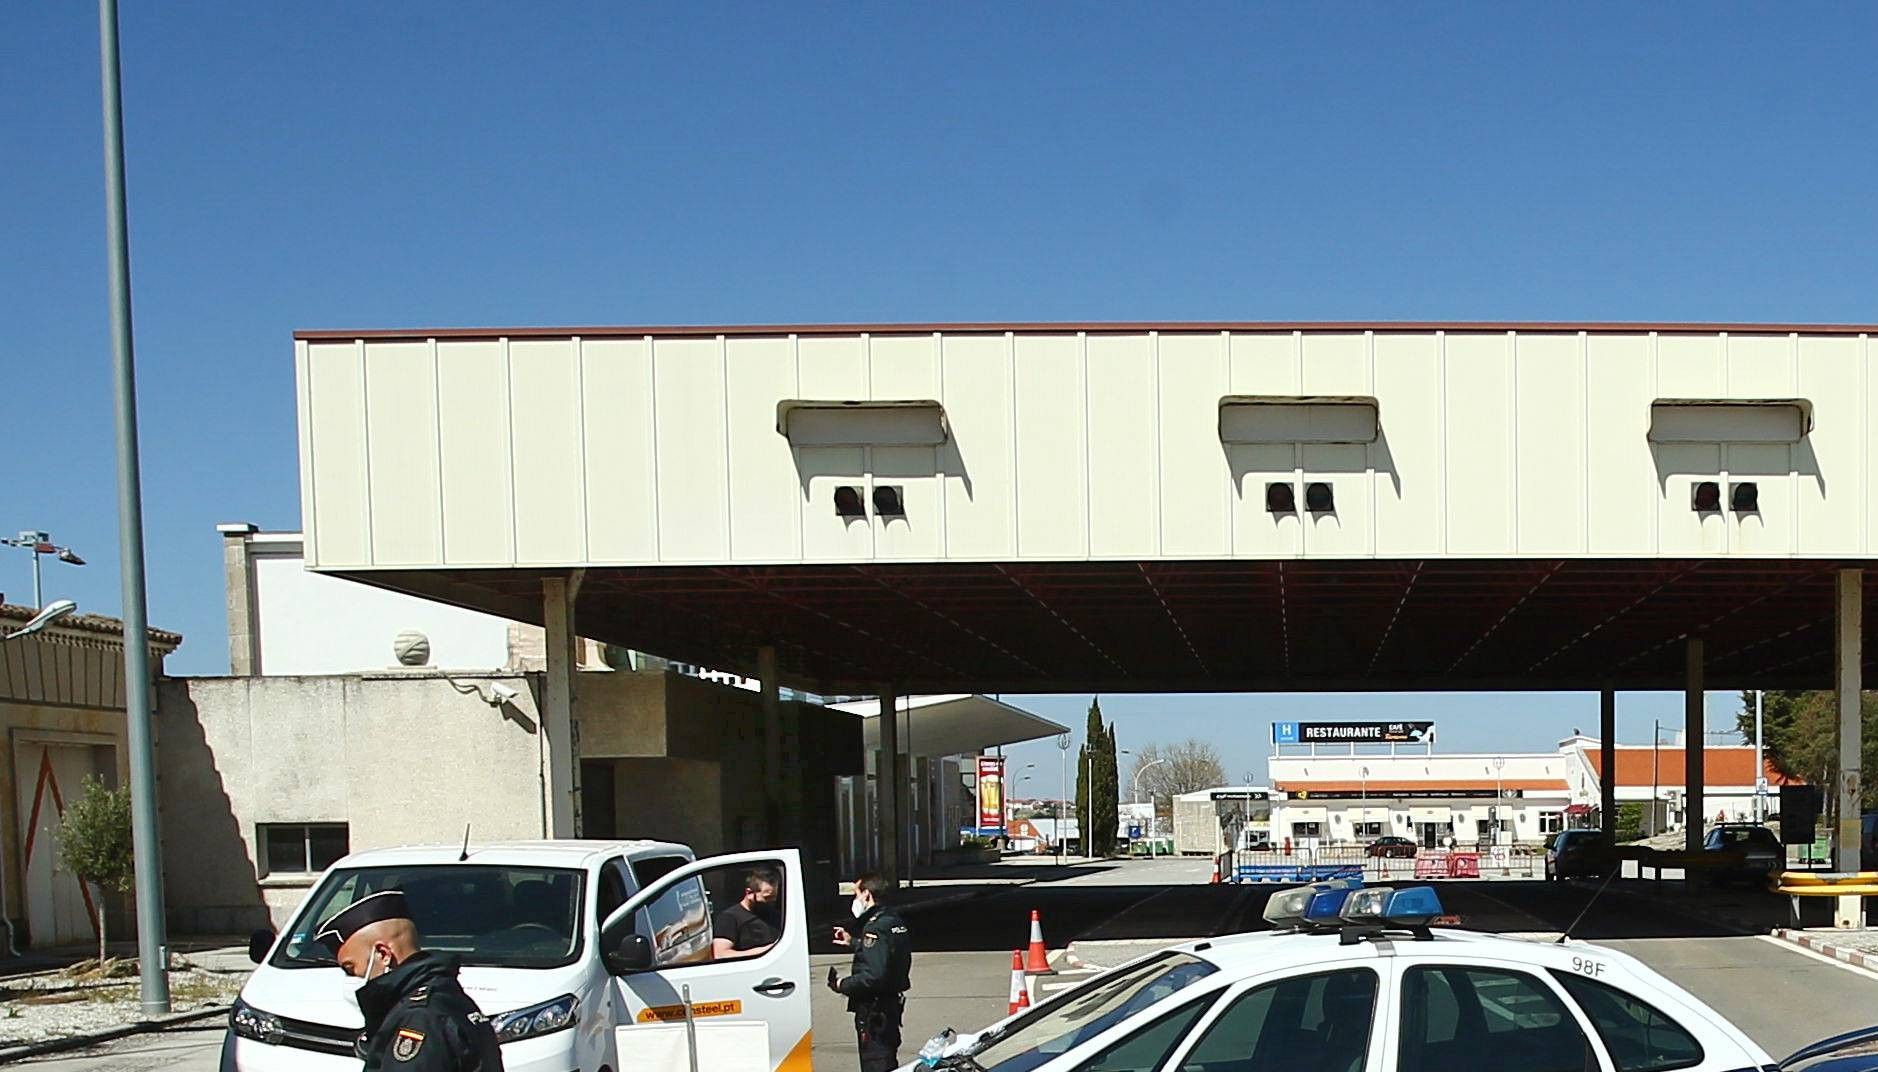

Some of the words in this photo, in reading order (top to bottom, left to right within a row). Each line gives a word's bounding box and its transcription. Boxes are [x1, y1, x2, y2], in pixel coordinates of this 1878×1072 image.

[1306, 726, 1381, 739] RESTAURANTE
[1572, 956, 1607, 978] 98F
[645, 1001, 735, 1020] www.cnsteel.pt
